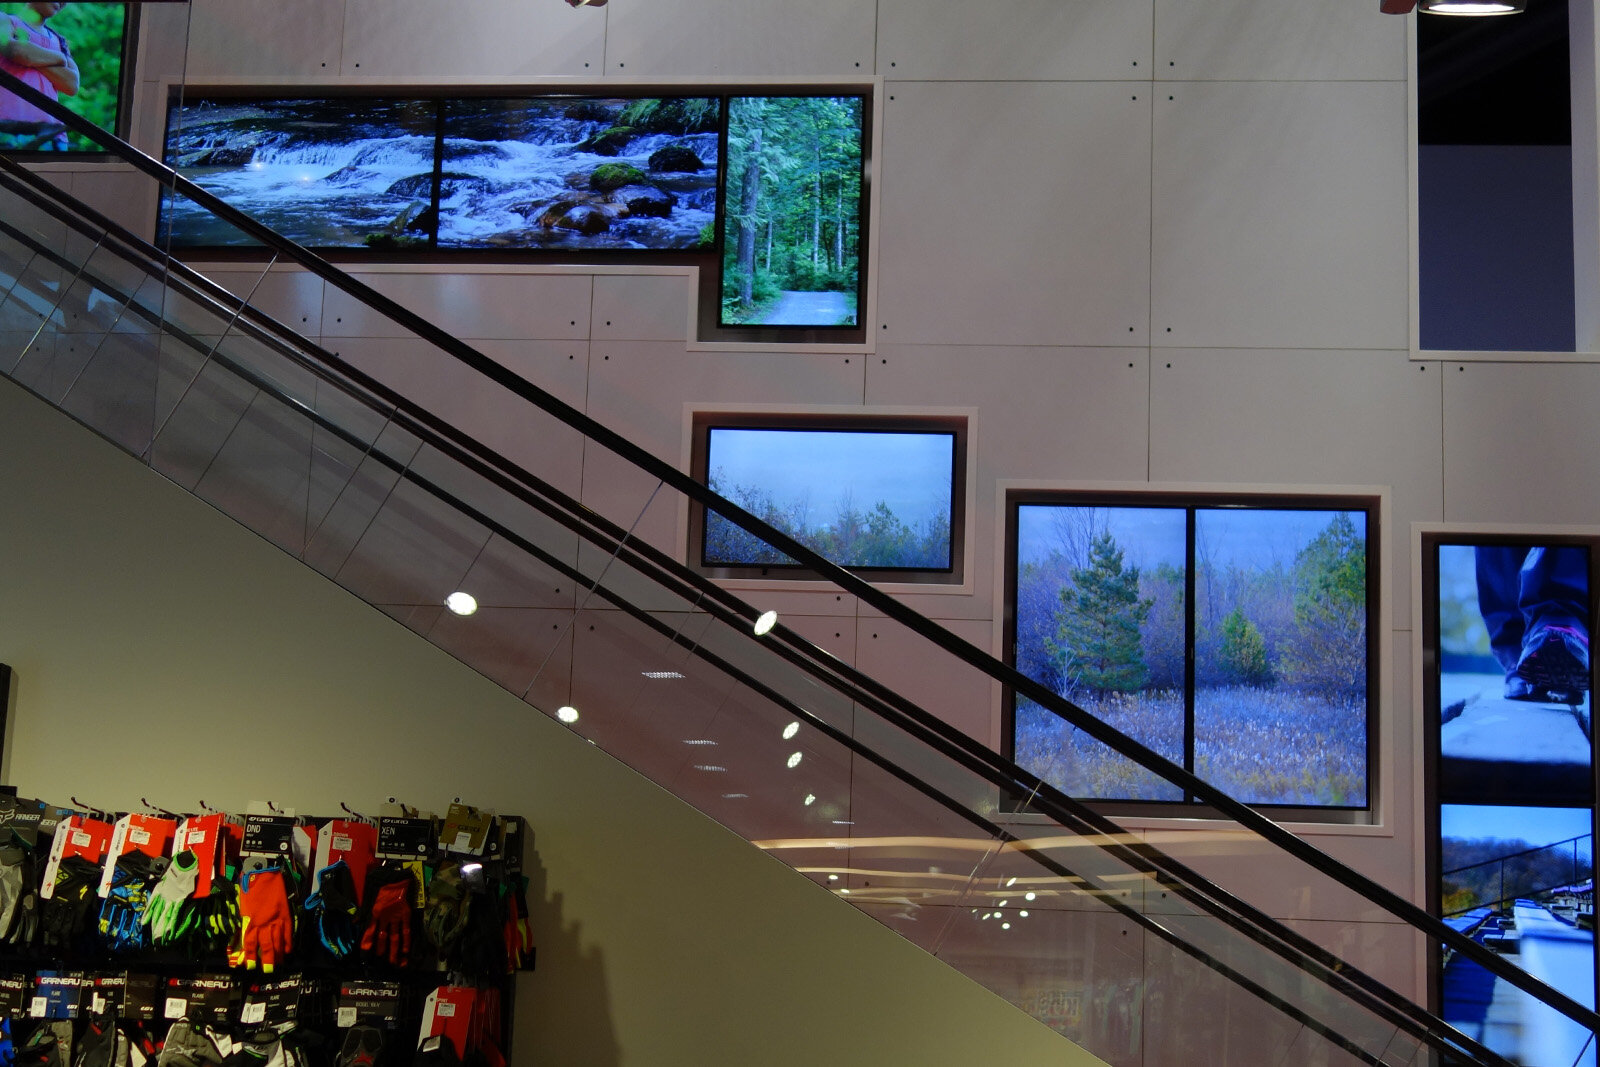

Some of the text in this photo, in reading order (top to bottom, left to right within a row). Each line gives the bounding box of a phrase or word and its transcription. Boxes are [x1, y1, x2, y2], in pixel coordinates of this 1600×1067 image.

[15, 813, 40, 822] RANGER
[246, 824, 261, 833] DND
[381, 826, 396, 836] XEN
[41, 977, 81, 986] GARNEAU
